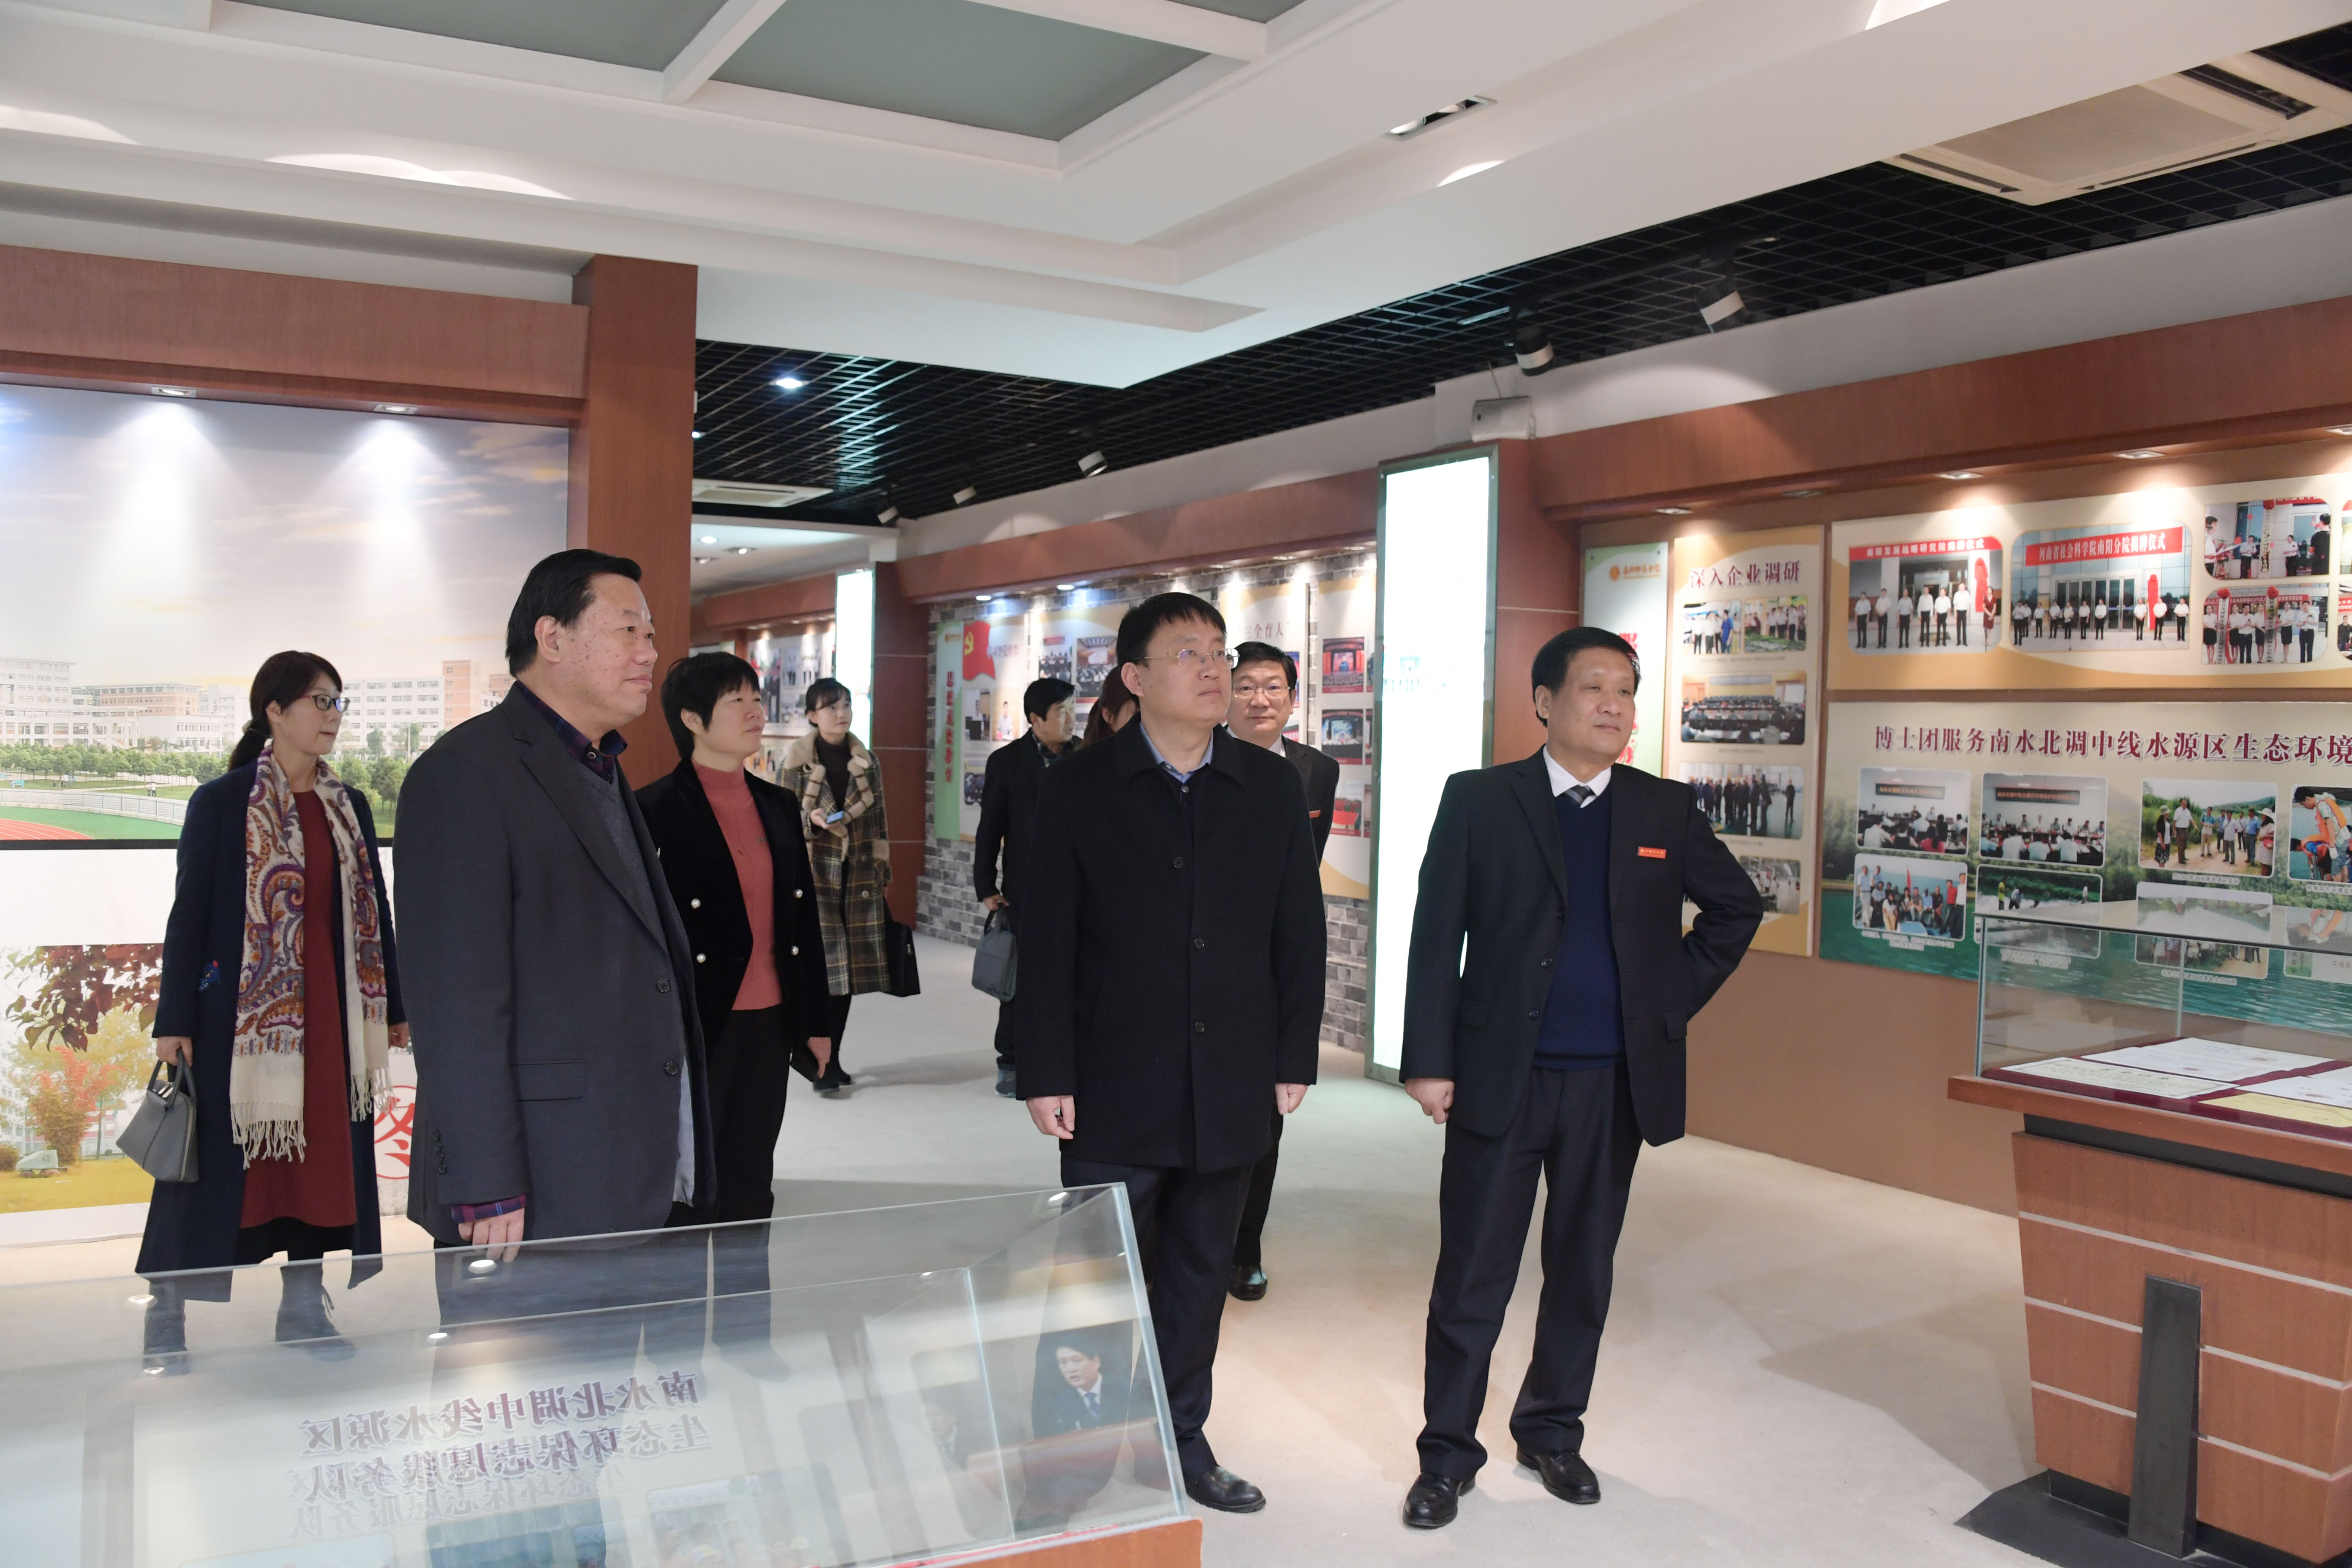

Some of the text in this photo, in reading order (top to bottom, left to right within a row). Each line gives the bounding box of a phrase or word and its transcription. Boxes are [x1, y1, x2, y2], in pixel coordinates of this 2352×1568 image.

[2039, 532, 2166, 561] 河南省社会科学院南阳分院揭牌仪式
[1690, 560, 1799, 588] 深入企业调研
[1876, 726, 2352, 765] 博士团服务南水北调中线水源区生态环境
